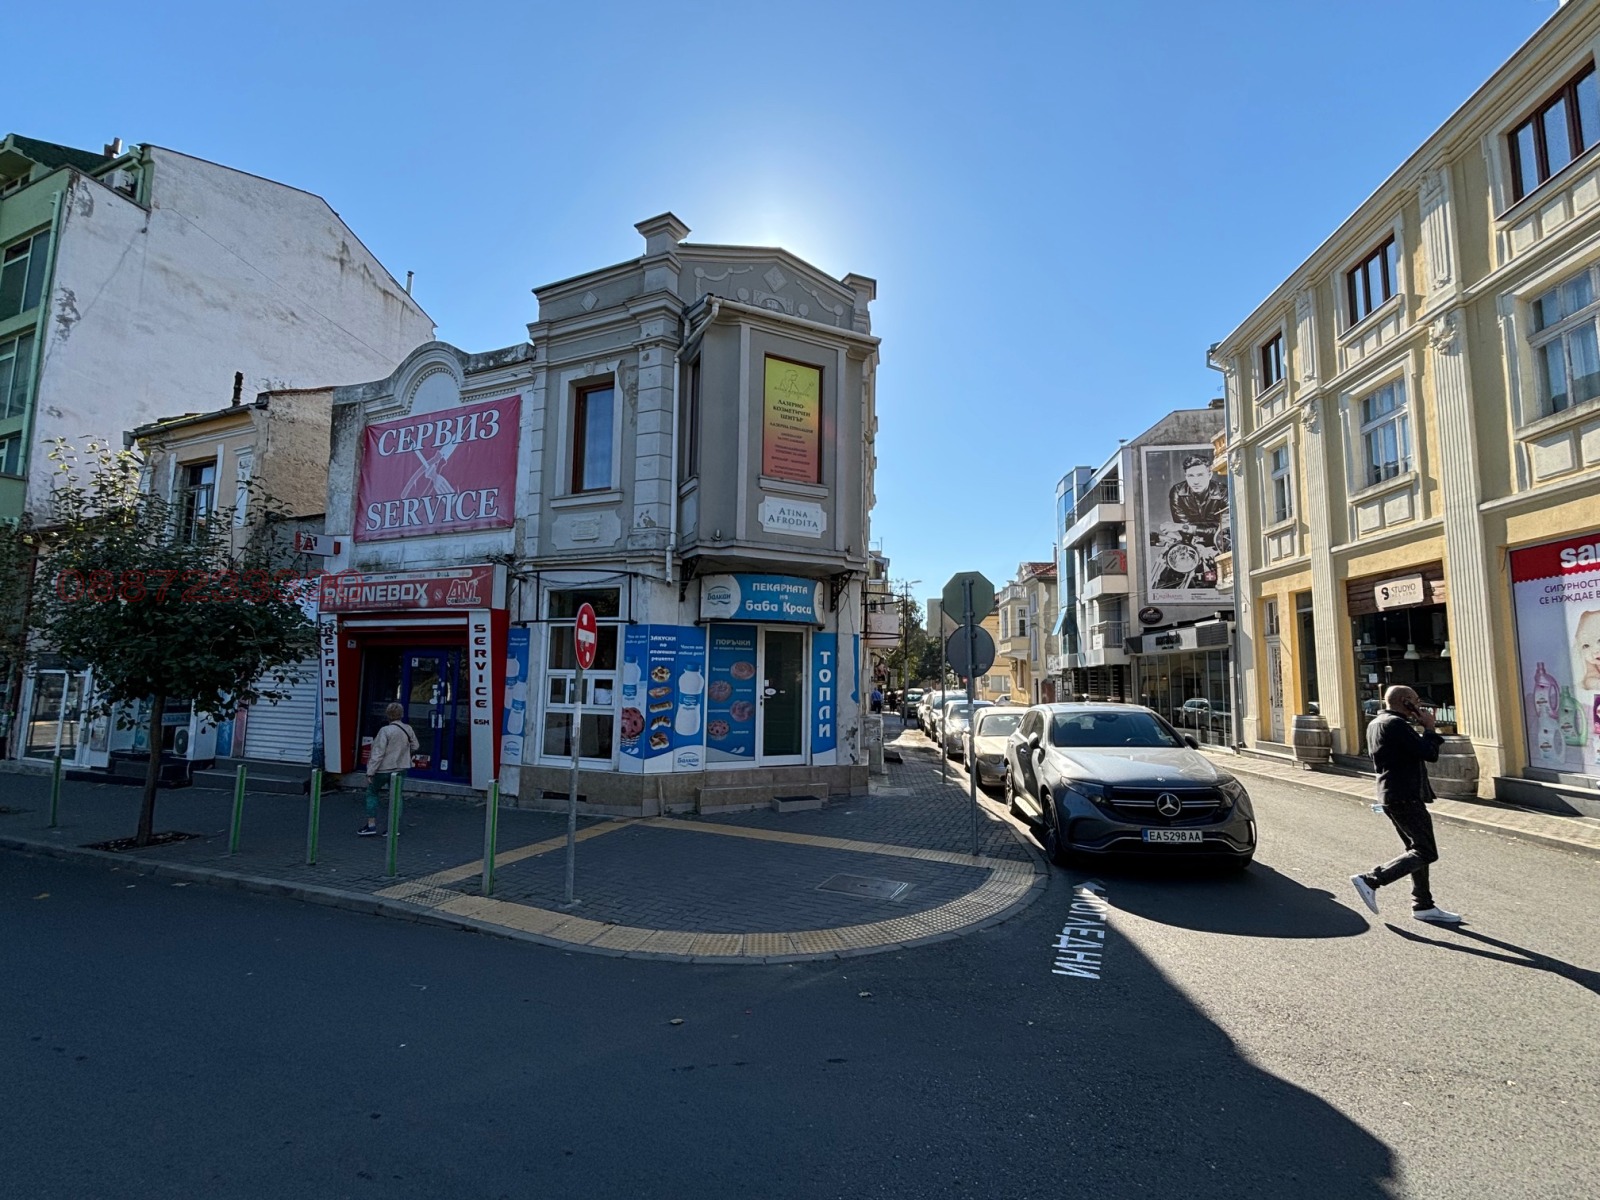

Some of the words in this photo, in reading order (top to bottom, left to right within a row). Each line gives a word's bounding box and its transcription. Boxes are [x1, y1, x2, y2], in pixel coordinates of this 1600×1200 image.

[378, 409, 501, 456] СЕРВИЗ
[366, 488, 499, 531] SERVICE
[778, 507, 808, 518] ATINA
[768, 514, 818, 528] AFRODITA
[324, 583, 428, 605] PHONEBOX
[752, 583, 808, 594] ПЕКАРНАТА
[707, 592, 732, 600] Балкан
[1540, 596, 1550, 605] СЕ
[1552, 591, 1594, 604] НУЖДАЕ
[746, 600, 778, 612] баба
[782, 602, 812, 614] Краси
[324, 626, 336, 688] REPAIR
[474, 624, 487, 708] SERVICE
[818, 651, 832, 738] ТОПЛИ
[1149, 832, 1162, 841] EA
[1163, 832, 1187, 841] 5298
[1188, 832, 1202, 842] AA
